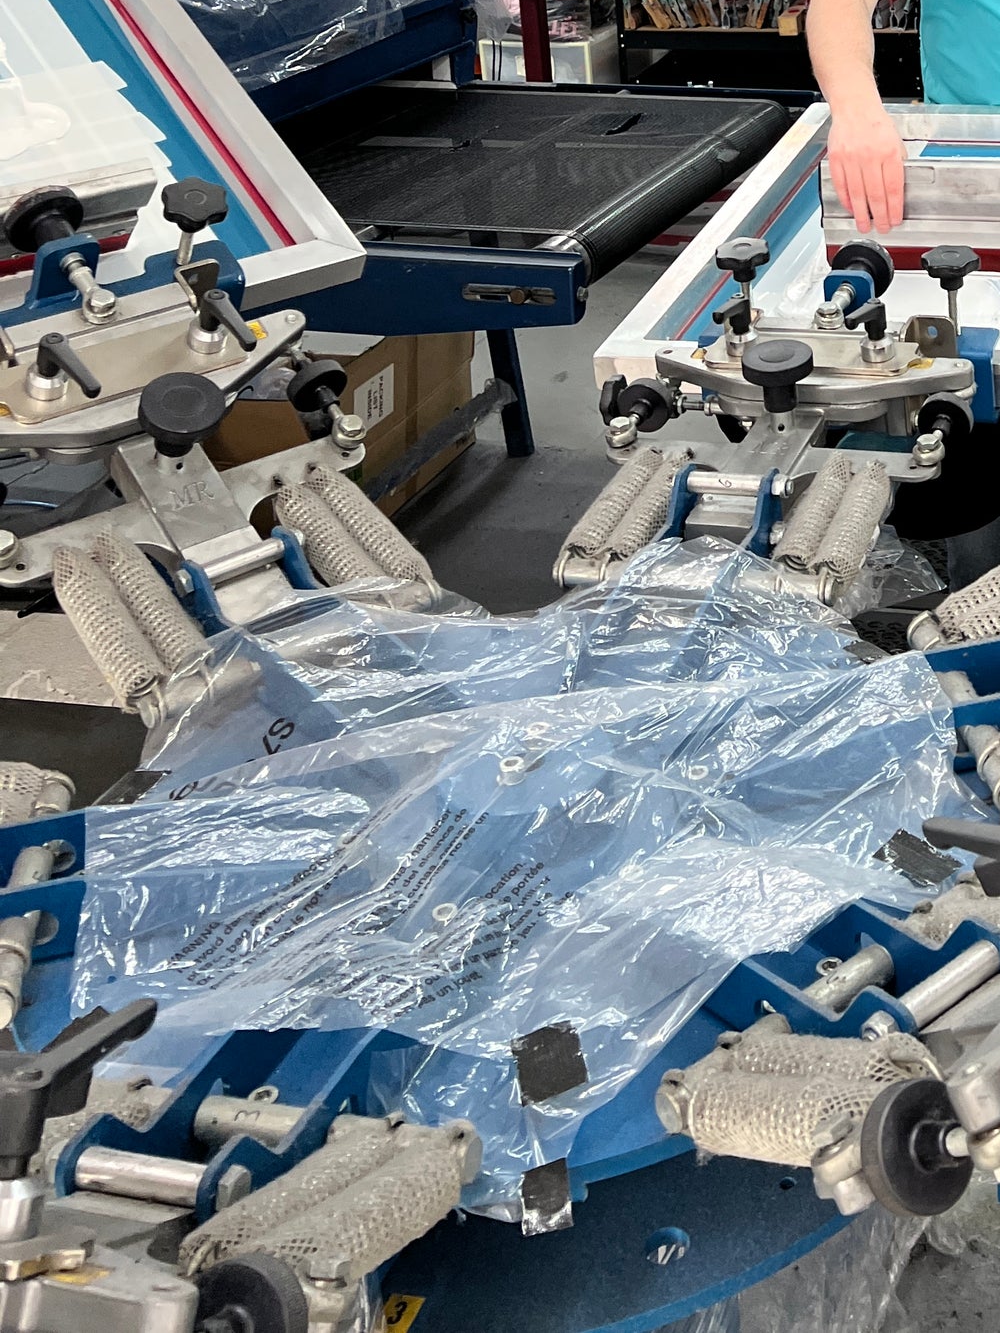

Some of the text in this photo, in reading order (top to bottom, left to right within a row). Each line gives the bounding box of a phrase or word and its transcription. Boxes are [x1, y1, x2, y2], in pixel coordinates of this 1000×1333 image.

[402, 870, 419, 887] del
[454, 808, 467, 823] de
[449, 842, 463, 857] no
[475, 811, 490, 825] un
[484, 862, 527, 899] ocation.
[511, 862, 544, 897] portée
[302, 890, 324, 914] not
[533, 892, 553, 907] ue
[436, 984, 455, 997] un
[386, 1301, 408, 1325] 3
